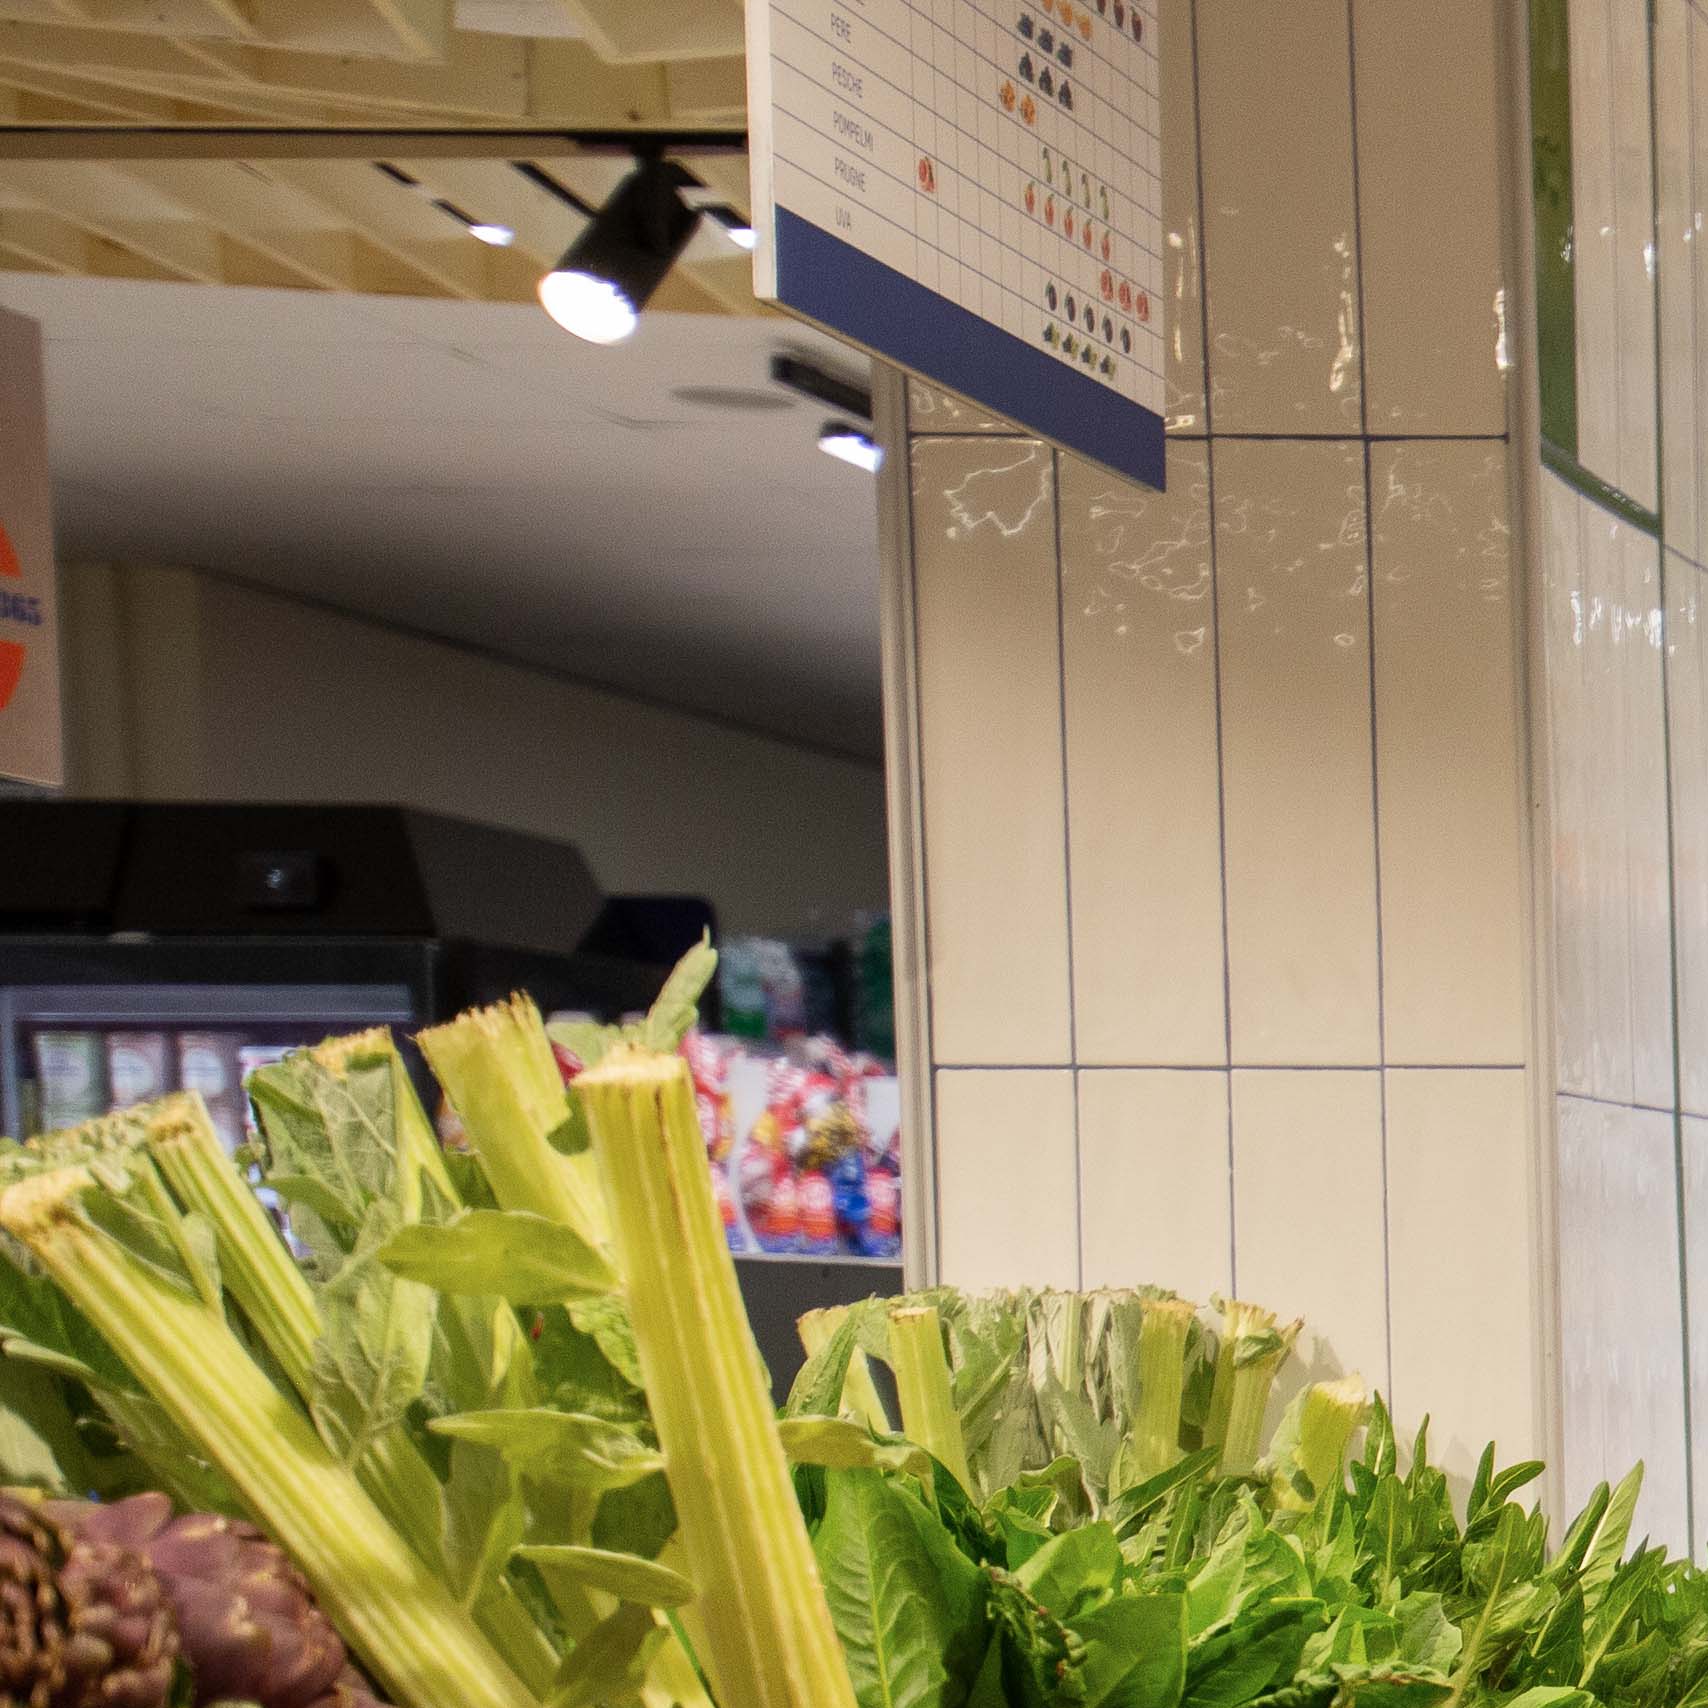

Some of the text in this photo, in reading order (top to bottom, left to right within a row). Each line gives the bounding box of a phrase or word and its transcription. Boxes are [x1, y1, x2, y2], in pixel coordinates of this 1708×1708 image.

[832, 62, 863, 98] PESCHE
[833, 110, 874, 152] POMPELMI
[834, 156, 866, 192] PRUGNE
[835, 207, 851, 230] UVA
